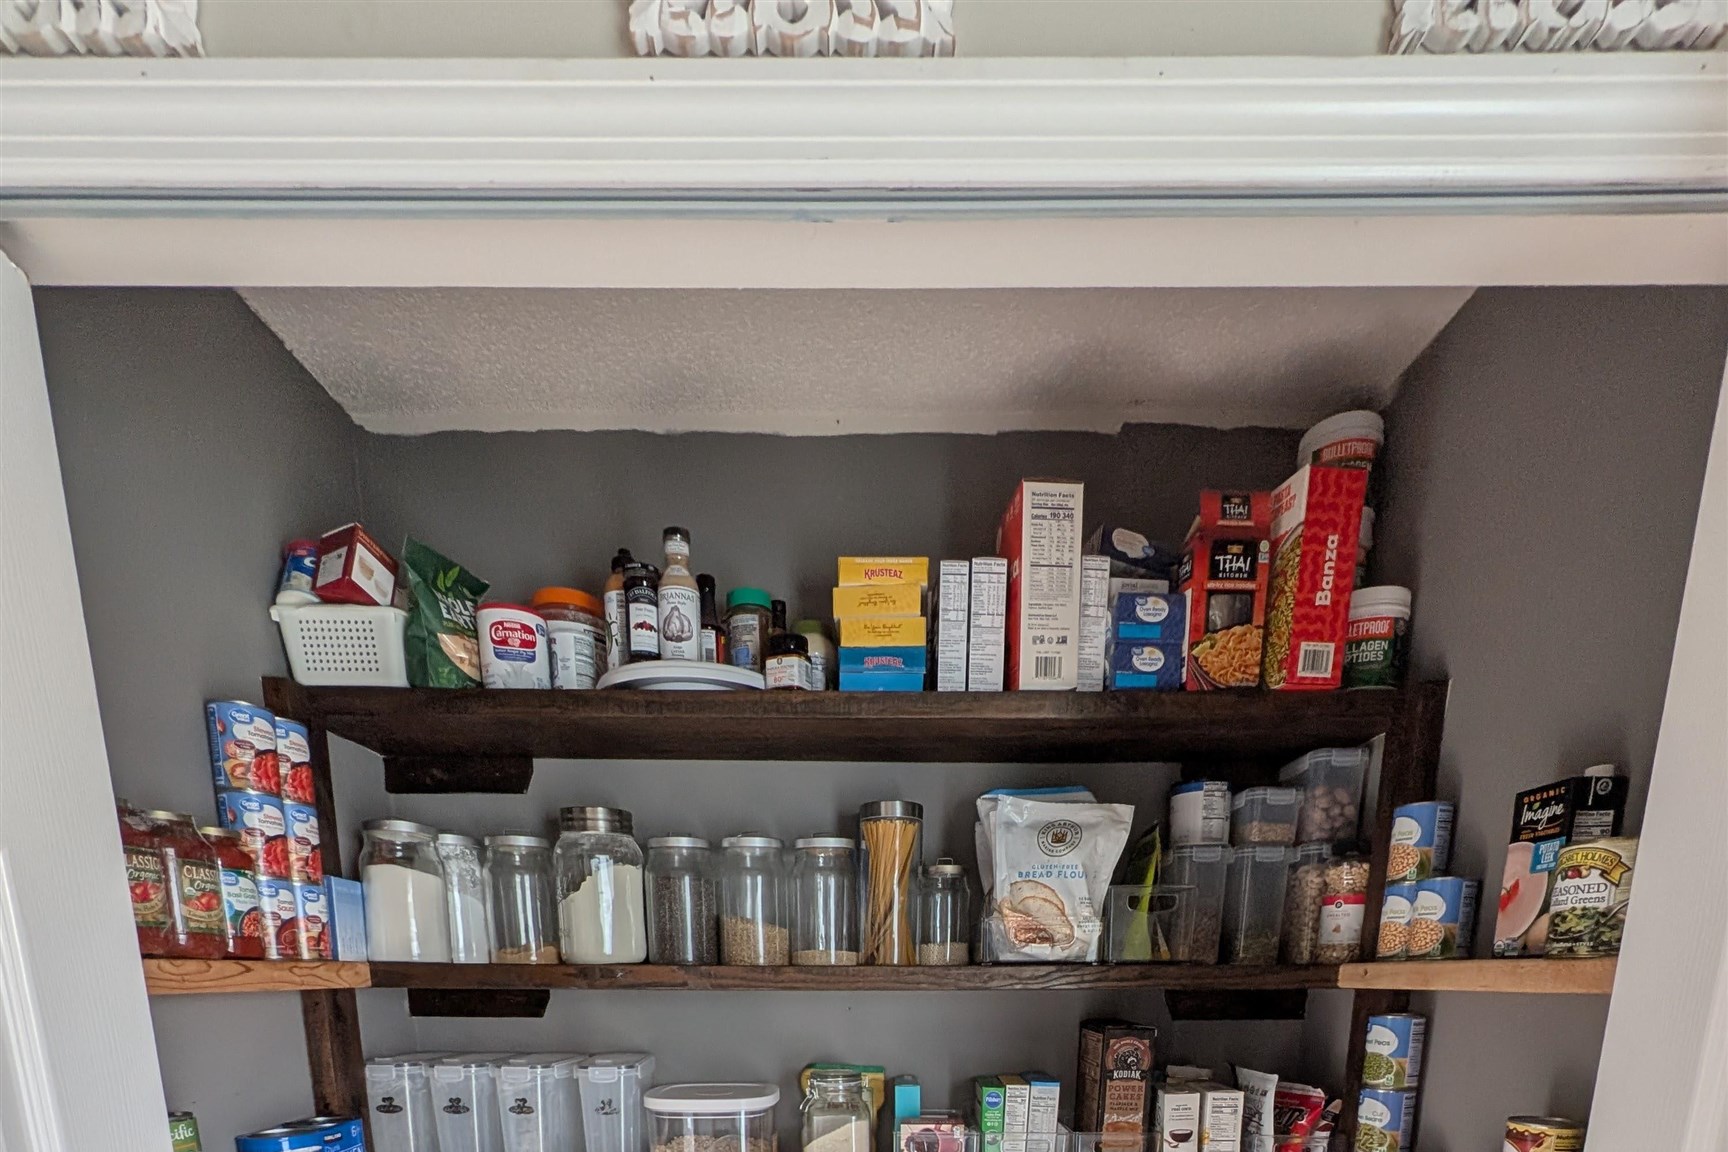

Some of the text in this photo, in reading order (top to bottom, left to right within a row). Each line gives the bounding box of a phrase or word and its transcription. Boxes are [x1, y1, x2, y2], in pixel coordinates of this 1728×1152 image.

[1223, 504, 1248, 517] THAI
[1215, 554, 1251, 572] THAI
[1315, 534, 1339, 606] Banza
[864, 568, 904, 580] KRUSTEAZ
[491, 624, 536, 642] Carnation
[1348, 620, 1391, 637] LETPROOF
[1345, 640, 1389, 654] LLAGEN
[1344, 651, 1384, 663] PTIDES
[1523, 786, 1566, 803] ORGANIC
[1520, 800, 1565, 831] Imagine
[1041, 821, 1080, 836] KING ARTHUR
[1581, 851, 1616, 867] HOLMES
[1552, 882, 1608, 898] EASONED
[1570, 895, 1606, 905] Greens
[1113, 1070, 1141, 1079] KODIAK
